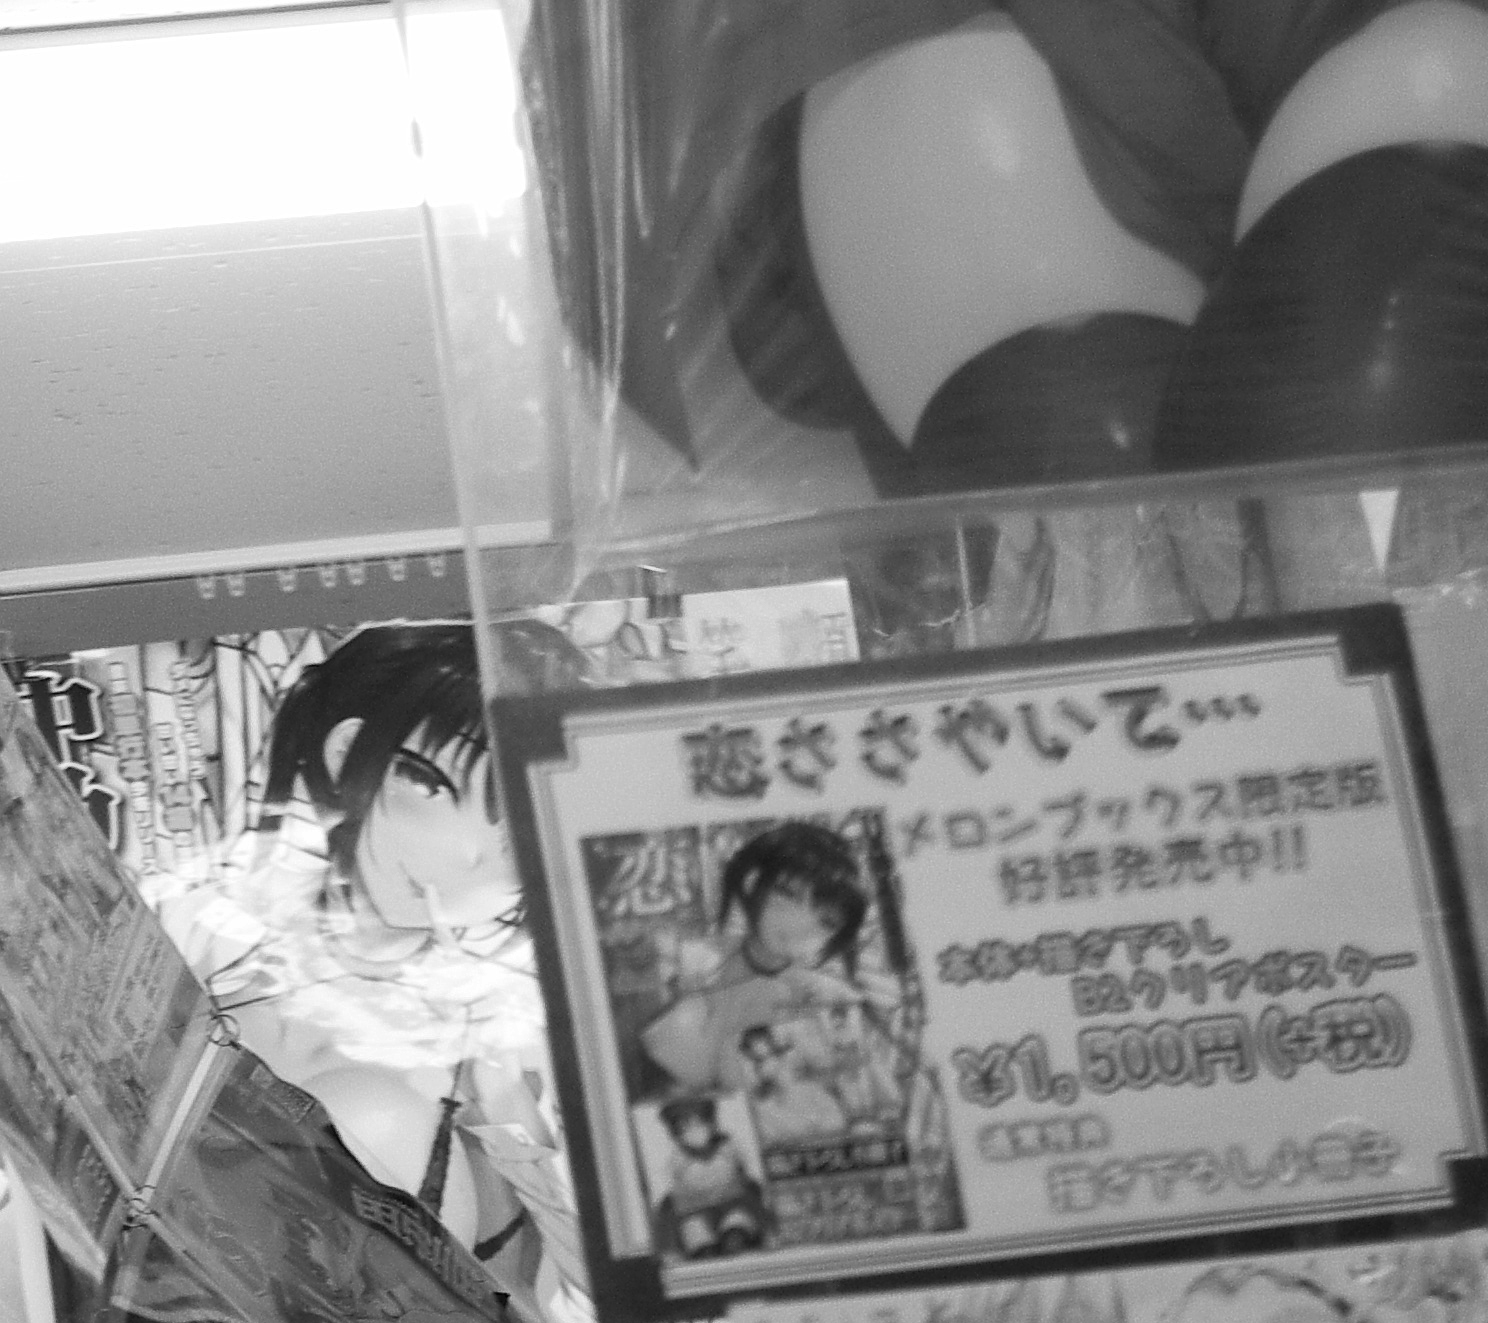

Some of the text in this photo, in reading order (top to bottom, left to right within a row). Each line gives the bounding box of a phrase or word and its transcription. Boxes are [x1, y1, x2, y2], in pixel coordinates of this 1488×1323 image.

[899, 760, 1387, 858] メロンブックス限定版
